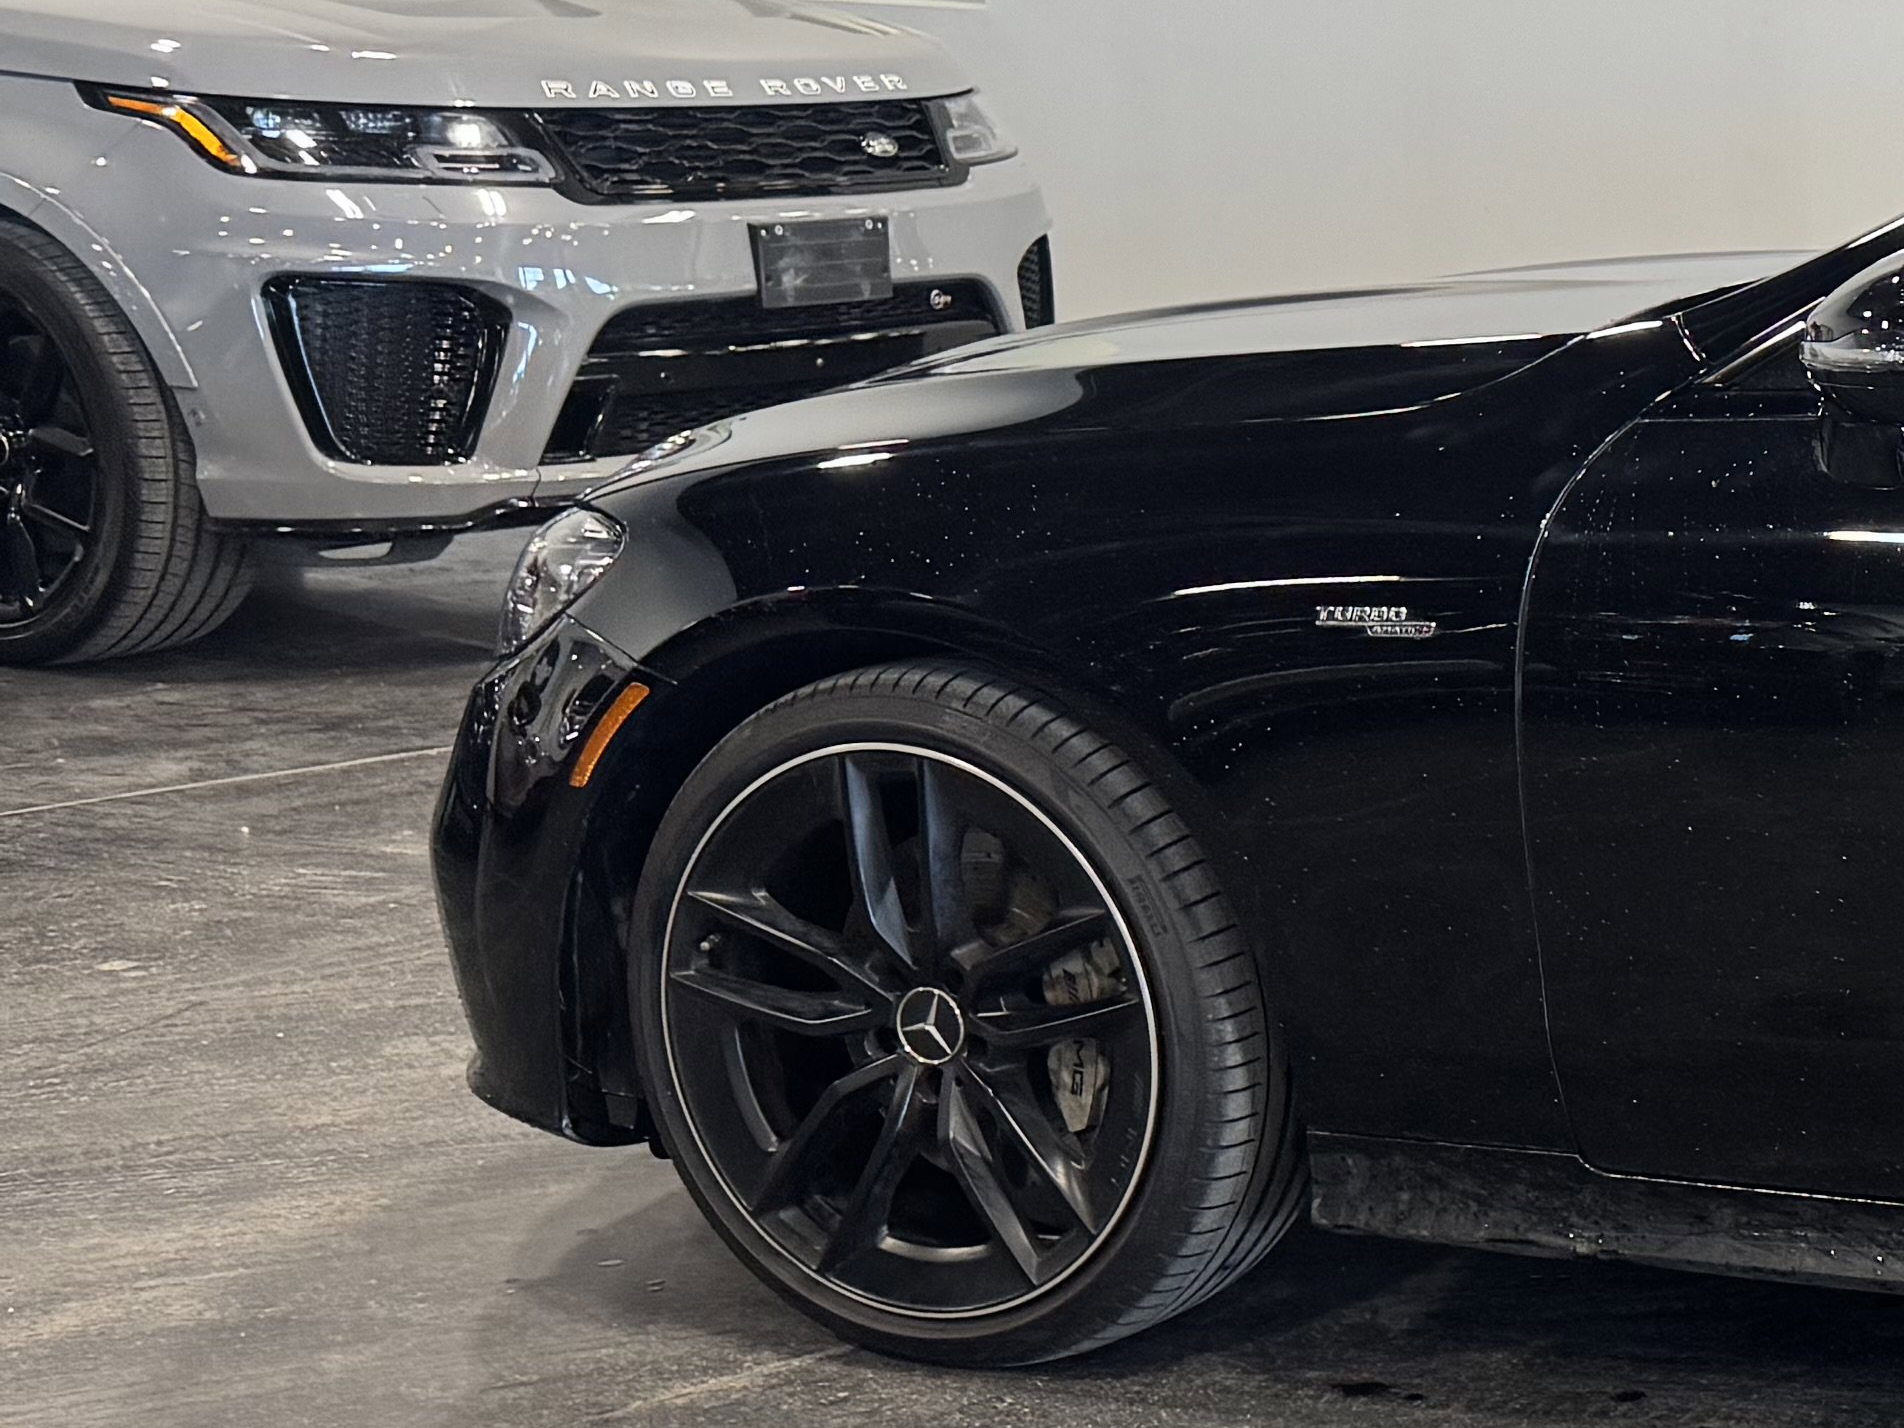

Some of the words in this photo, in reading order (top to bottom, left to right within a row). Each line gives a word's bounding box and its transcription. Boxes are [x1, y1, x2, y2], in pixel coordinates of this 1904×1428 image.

[541, 79, 733, 99] RANGE
[759, 73, 908, 96] ROVER
[1070, 1040, 1085, 1097] MG
